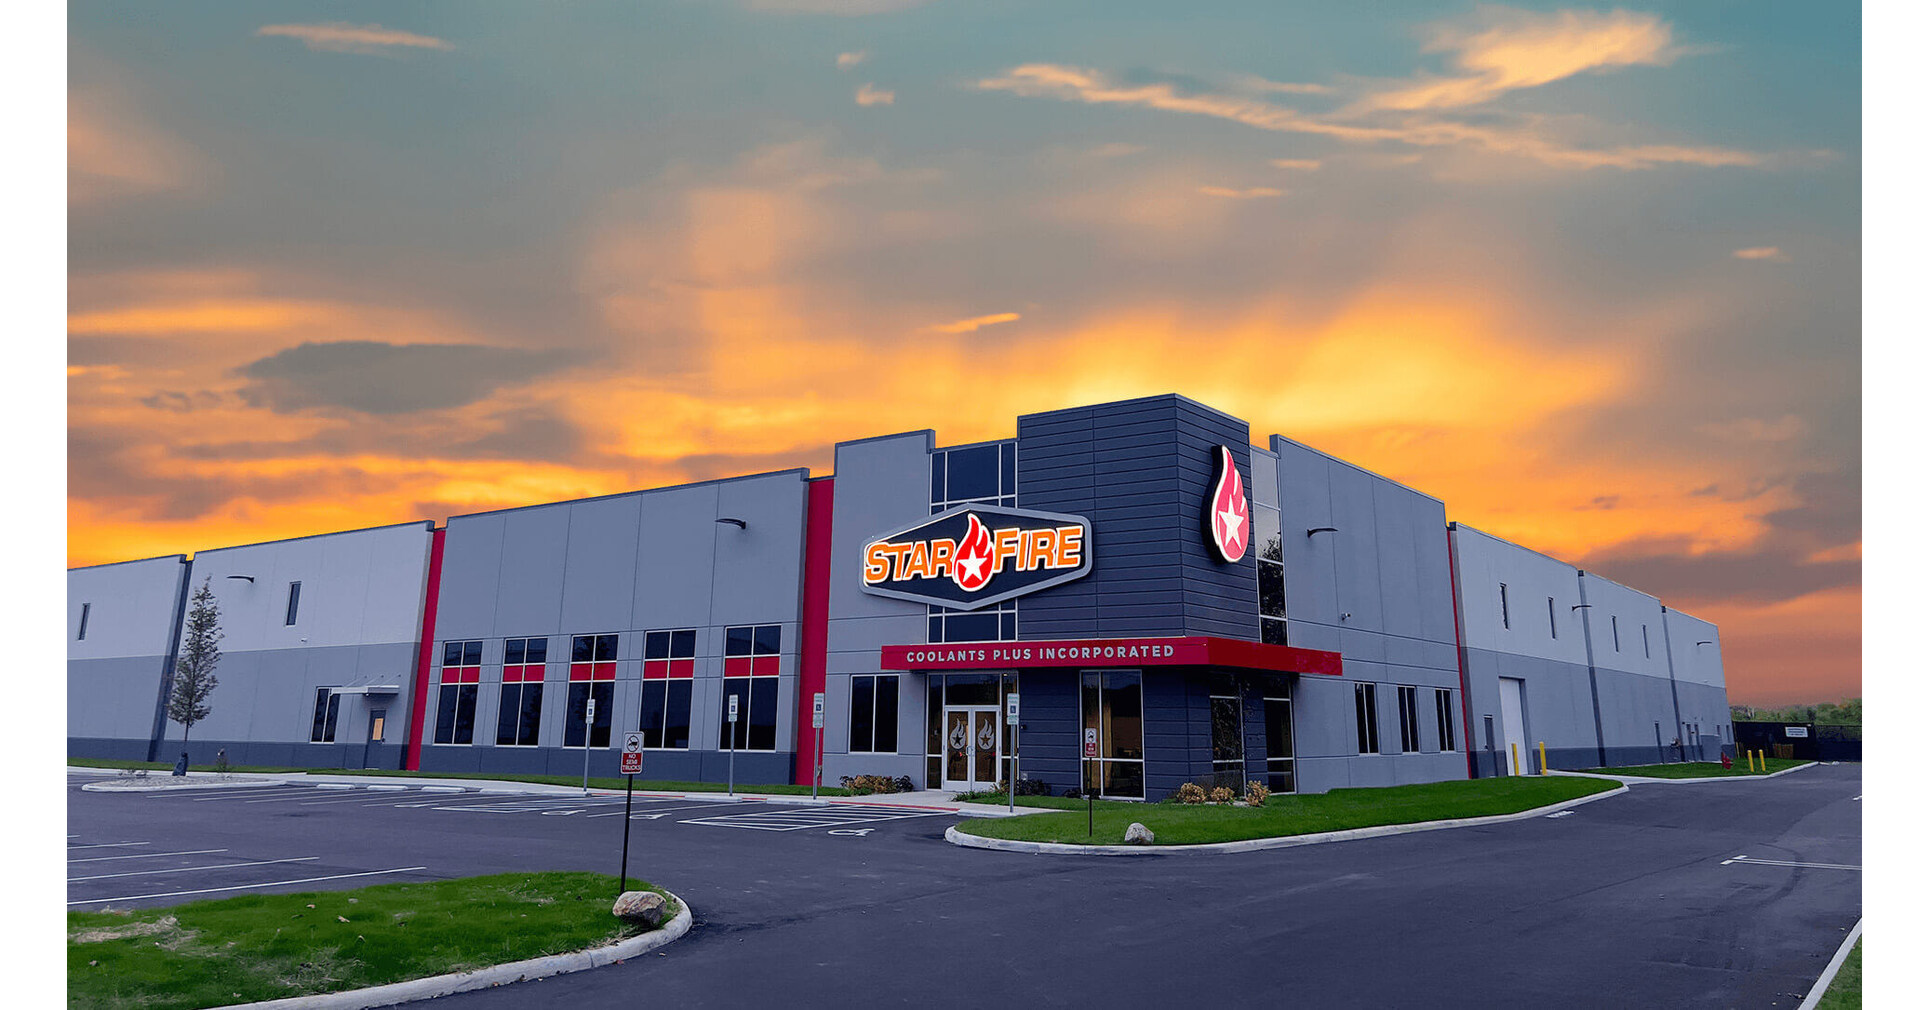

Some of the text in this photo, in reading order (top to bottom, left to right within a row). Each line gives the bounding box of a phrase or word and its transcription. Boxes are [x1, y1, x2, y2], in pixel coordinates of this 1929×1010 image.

[864, 525, 1083, 583] STAR FIRE
[907, 645, 1174, 663] COOLANTS PLUS INCORPORATED
